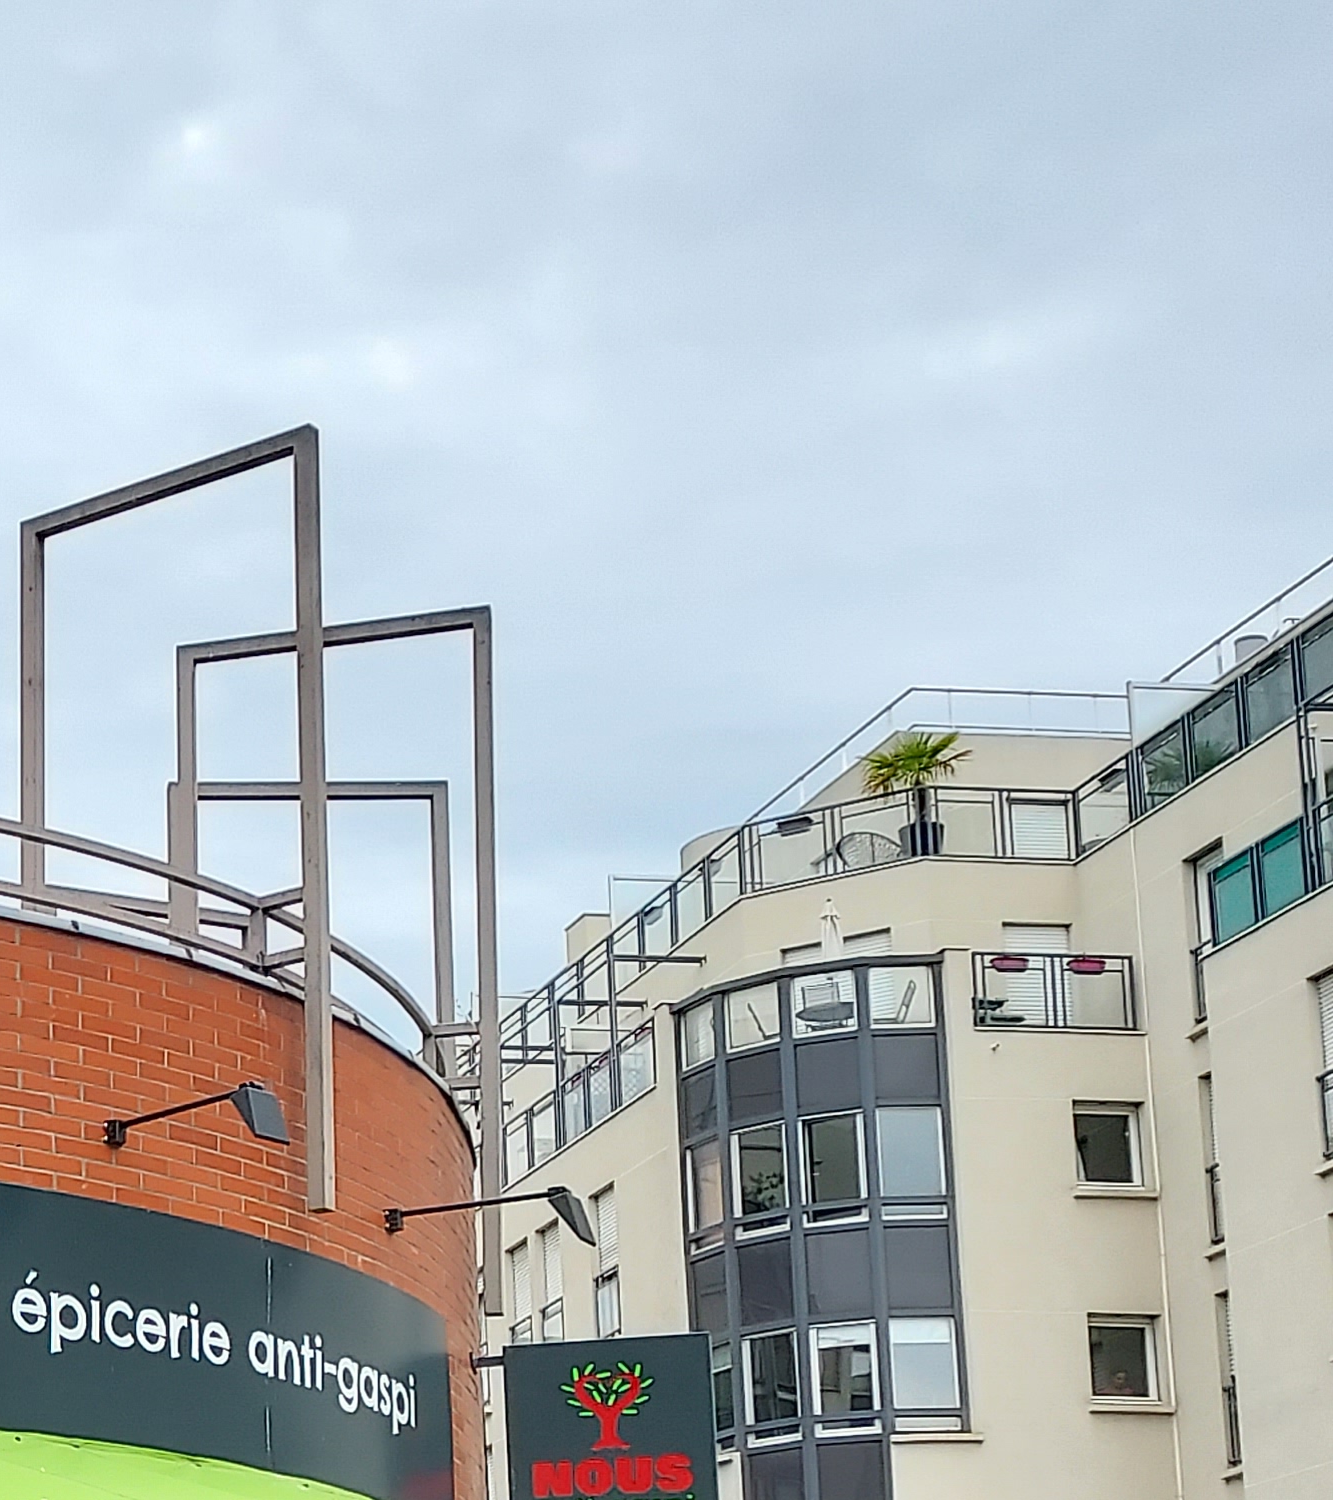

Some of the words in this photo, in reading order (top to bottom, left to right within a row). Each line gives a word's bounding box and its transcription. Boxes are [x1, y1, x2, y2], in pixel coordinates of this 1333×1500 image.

[12, 1269, 231, 1365] épicerie
[248, 1331, 417, 1435] anti-gaspi
[532, 1453, 693, 1498] NOUS
